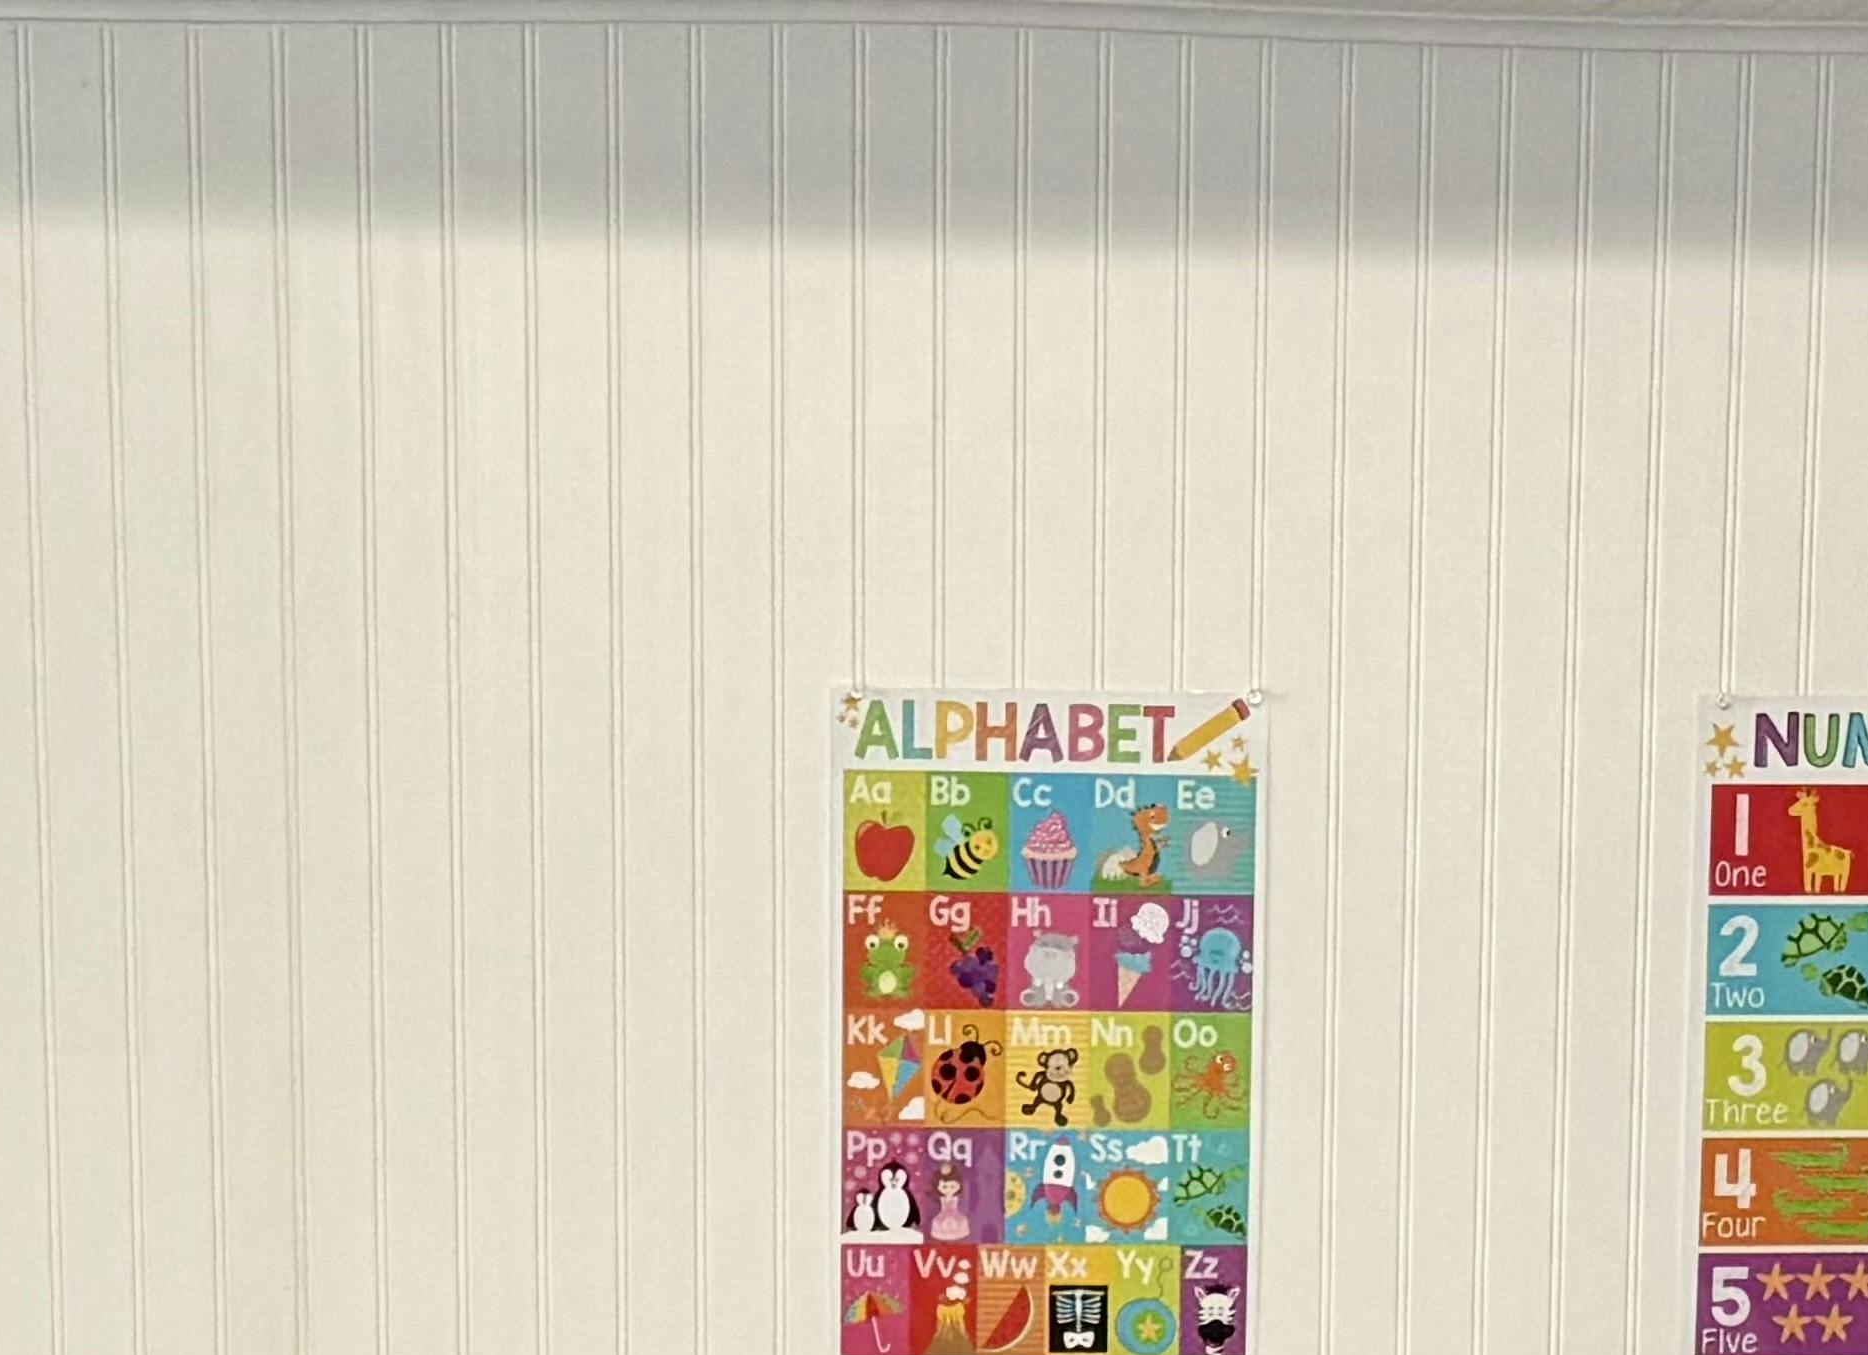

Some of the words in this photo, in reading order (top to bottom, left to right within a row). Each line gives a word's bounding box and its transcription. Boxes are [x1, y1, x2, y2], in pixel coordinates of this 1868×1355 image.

[854, 699, 1176, 764] ALPHABET
[850, 777, 892, 806] Aa
[931, 777, 971, 806] Bb
[1012, 778, 1052, 807] Cc
[1095, 779, 1136, 808] Dd
[1176, 780, 1216, 809] Ee
[1734, 793, 1750, 857] 1
[1715, 861, 1767, 888] One
[847, 896, 883, 925] Ff
[930, 897, 972, 932] Gg
[1011, 897, 1052, 927] Hh
[1093, 898, 1118, 928] Ii
[1175, 898, 1200, 934] Jj
[1719, 915, 1760, 977] 2
[1710, 983, 1765, 1009] Two
[846, 1015, 888, 1046] Kk
[929, 1017, 952, 1046] Ll
[1009, 1018, 1072, 1046] Mm
[1091, 1018, 1134, 1047] Nn
[1172, 1019, 1218, 1048] Oo
[1728, 1034, 1768, 1097] 3
[1705, 1098, 1789, 1125] Three
[846, 1133, 886, 1166] Pp
[927, 1134, 973, 1167] Qq
[1009, 1134, 1045, 1161] Rr
[1090, 1134, 1123, 1162] Ss
[1171, 1135, 1202, 1162] Tt
[1714, 1148, 1757, 1209] 4
[1702, 1211, 1766, 1239] Four
[846, 1250, 885, 1279] Uu
[913, 1250, 956, 1279] Vv
[979, 1250, 1038, 1279] Ww
[1048, 1250, 1087, 1279] Xx
[1115, 1250, 1155, 1284] Yy
[1184, 1250, 1218, 1279] Zz
[1711, 1266, 1751, 1327] 5
[1701, 1328, 1758, 1355] Five
